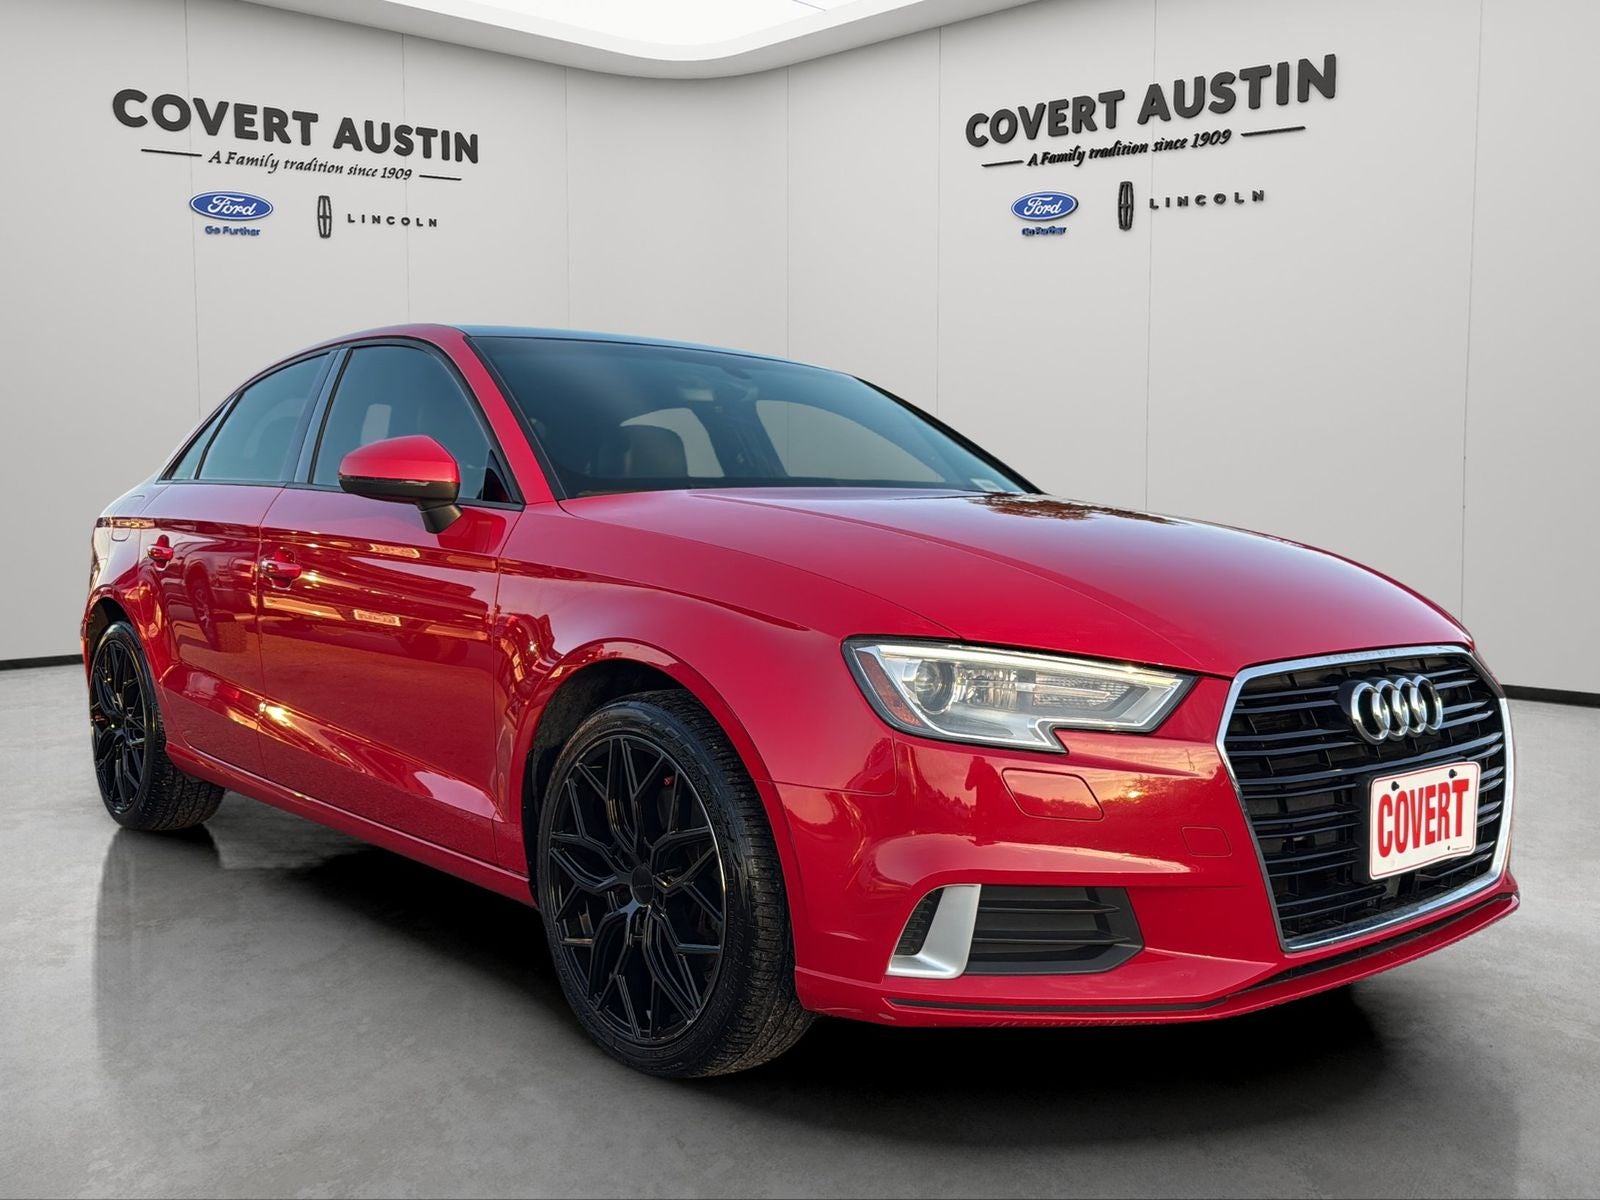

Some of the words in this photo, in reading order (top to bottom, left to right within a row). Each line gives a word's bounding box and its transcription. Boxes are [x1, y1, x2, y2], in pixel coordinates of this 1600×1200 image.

[965, 88, 1126, 149] COVERT
[1136, 53, 1337, 126] AUSTIN
[112, 88, 319, 147] COVERT
[332, 116, 479, 165] AUSTIN
[1026, 152, 1039, 167] A
[1039, 145, 1087, 168] Family
[1088, 139, 1149, 160] tradition
[1151, 137, 1189, 153] since
[1190, 128, 1233, 149] 1909
[207, 150, 222, 165] A
[224, 152, 280, 175] Family
[283, 157, 344, 174] tradition
[347, 163, 379, 178] since
[380, 166, 413, 181] 1909
[207, 195, 257, 215] Ford
[1023, 196, 1063, 216] Ford
[1149, 189, 1265, 211] LINCOLN
[204, 225, 221, 235] Go
[222, 225, 261, 237] Further
[347, 213, 438, 228] LINCOLN
[1377, 778, 1470, 858] COVERT
